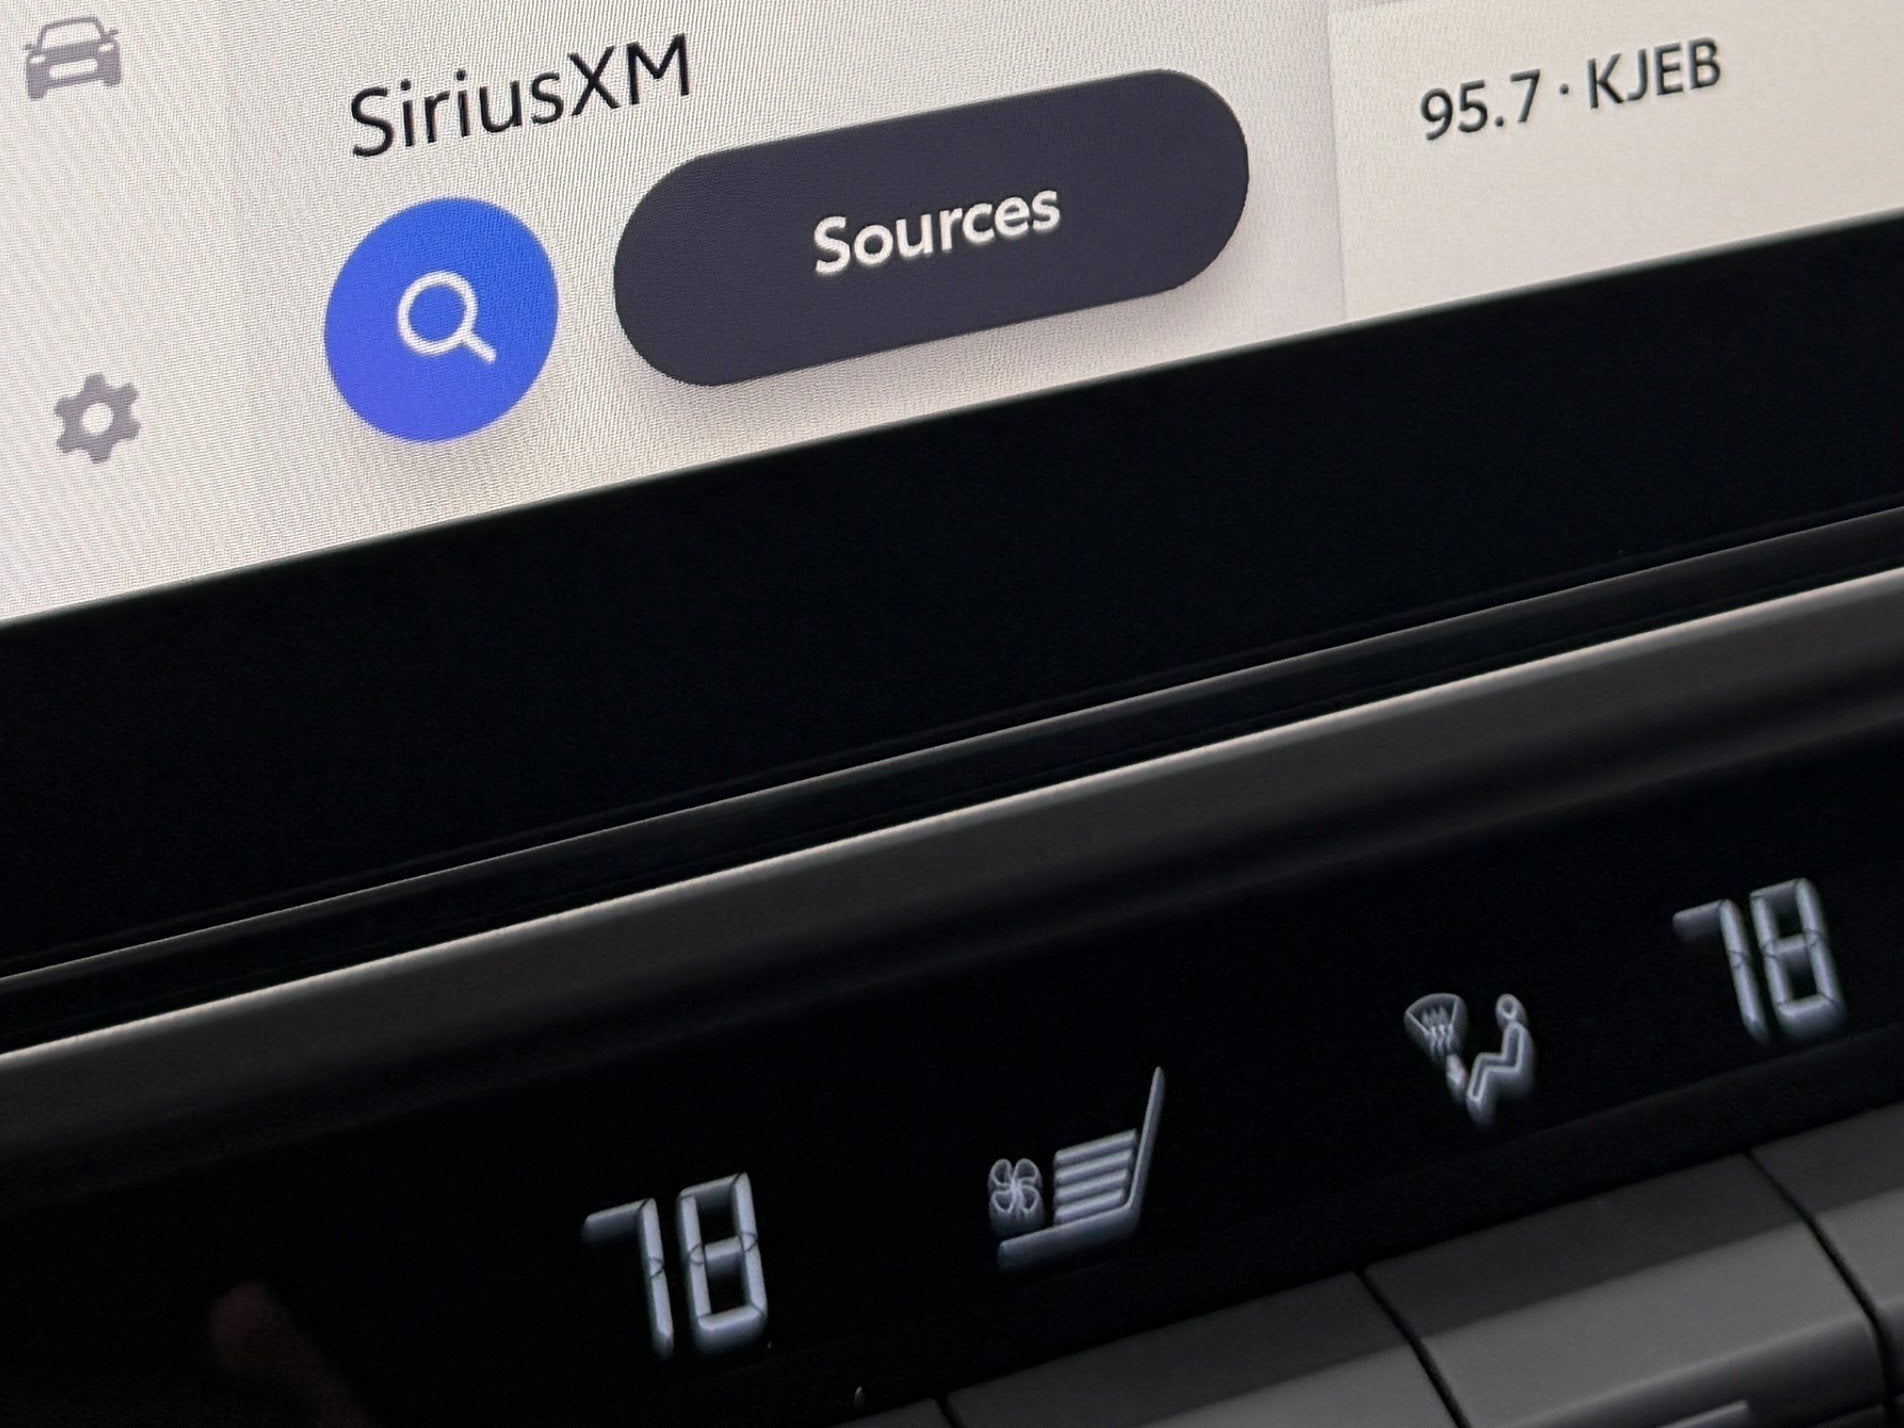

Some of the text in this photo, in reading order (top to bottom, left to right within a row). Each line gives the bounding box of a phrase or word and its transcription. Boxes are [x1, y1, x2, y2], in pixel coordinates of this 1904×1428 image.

[349, 33, 693, 159] SiriusXM
[1420, 69, 1542, 142] 95.7
[1588, 38, 1723, 110] KJEB
[813, 190, 1061, 276] Sources
[1673, 878, 1846, 1041] 78
[583, 1172, 769, 1357] 78
